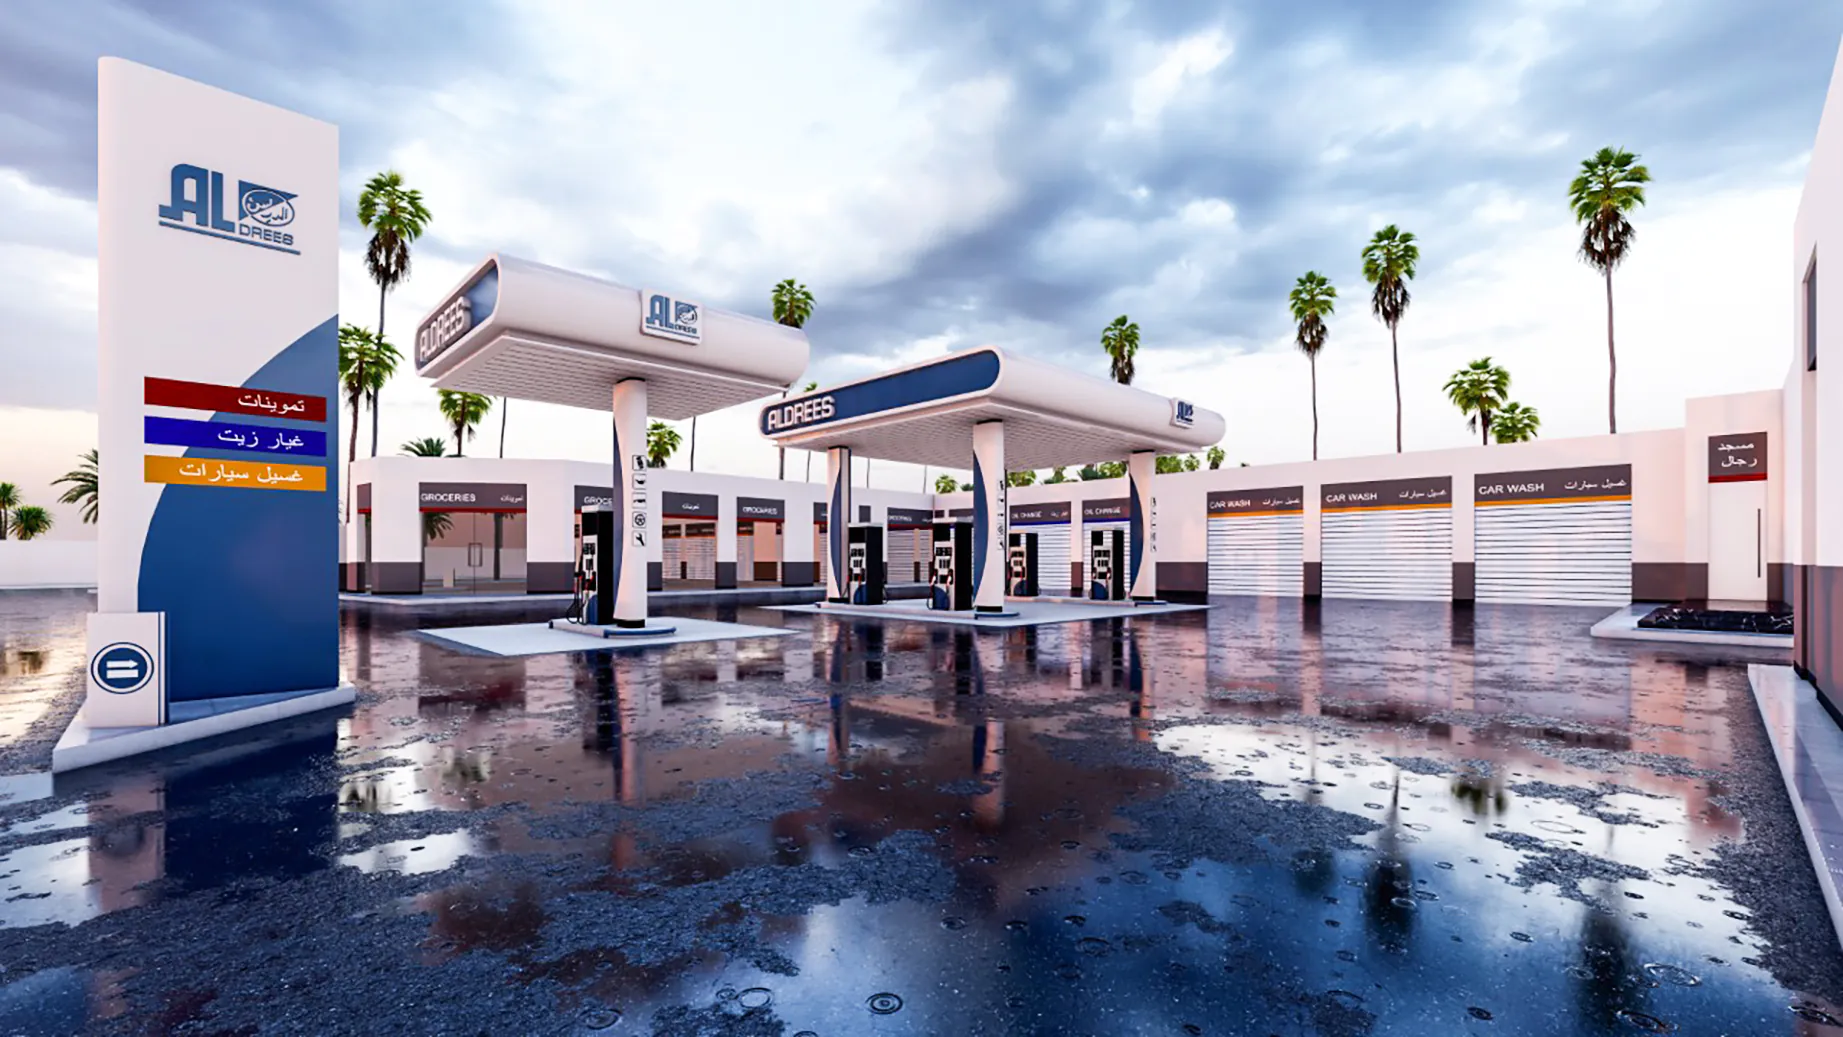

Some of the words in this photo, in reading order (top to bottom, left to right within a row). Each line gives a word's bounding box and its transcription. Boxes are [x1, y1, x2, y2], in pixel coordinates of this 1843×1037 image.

[159, 163, 235, 233] AL
[239, 223, 294, 246] DREES
[645, 294, 674, 329] AL
[420, 296, 469, 361] ALDREES
[238, 394, 305, 415] تموينات
[768, 396, 835, 431] ALDREES
[217, 429, 259, 448] زيت
[267, 432, 304, 449] غيار
[1718, 443, 1755, 453] مسجد
[1721, 455, 1758, 468] رجال
[179, 463, 249, 482] سيارات
[257, 466, 303, 484] غسيل
[420, 493, 476, 502] GROCERIES
[1325, 494, 1346, 503] CAR
[1348, 492, 1378, 501] WASH
[1478, 485, 1504, 495] CAR
[1507, 483, 1545, 493] WASH
[583, 496, 612, 505] GROCE
[1209, 501, 1226, 509] CAR
[1227, 500, 1251, 508] WASH
